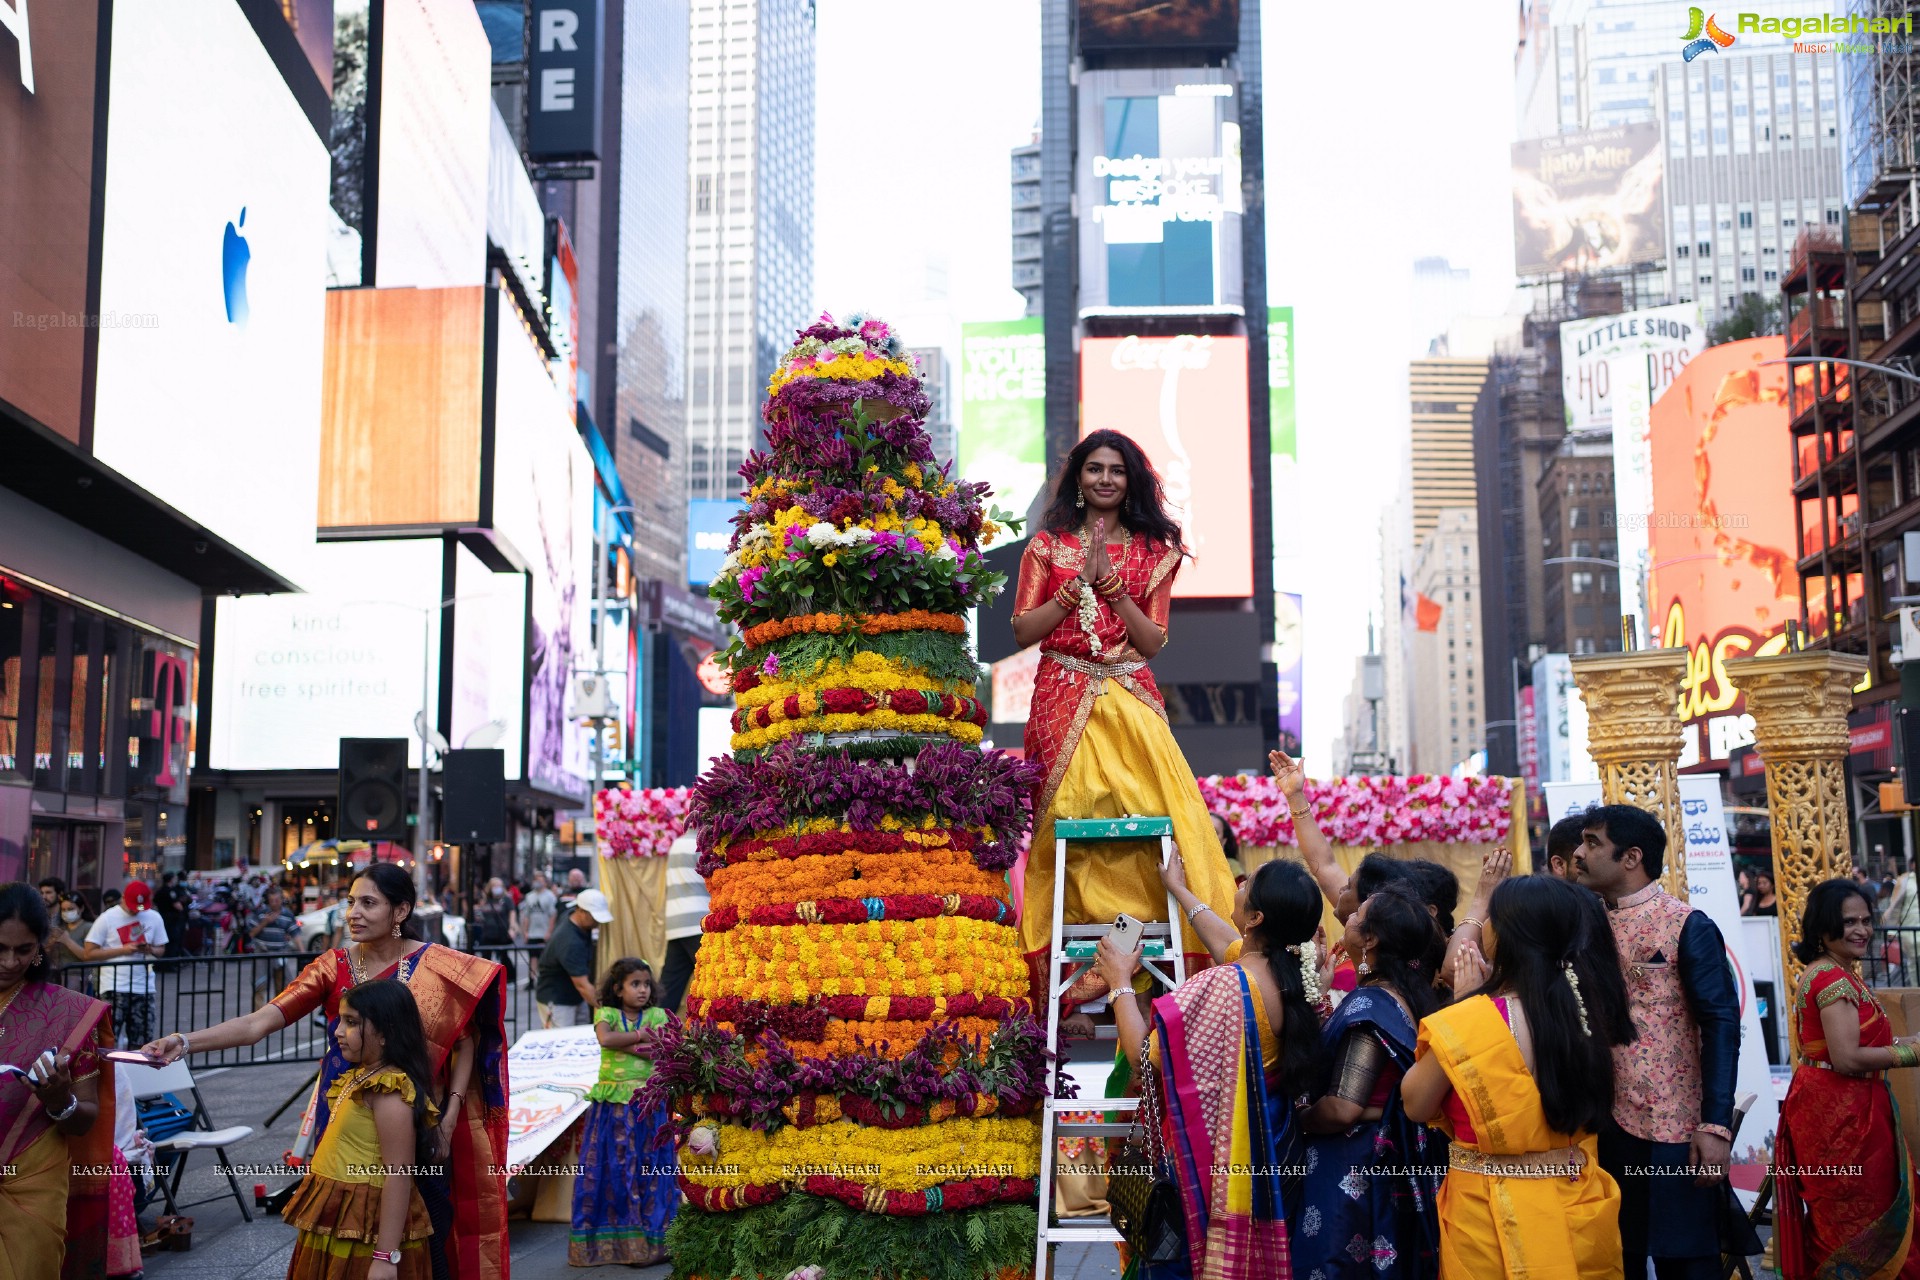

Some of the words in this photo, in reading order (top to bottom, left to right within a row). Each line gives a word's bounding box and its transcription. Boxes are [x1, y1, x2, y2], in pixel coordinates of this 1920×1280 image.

[1578, 319, 1639, 357] LITTLE
[1645, 318, 1692, 342] SHOP
[965, 348, 1045, 373] YOUR
[964, 370, 1045, 402] RICE
[241, 680, 287, 699] free
[1688, 850, 1725, 858] AMERICA
